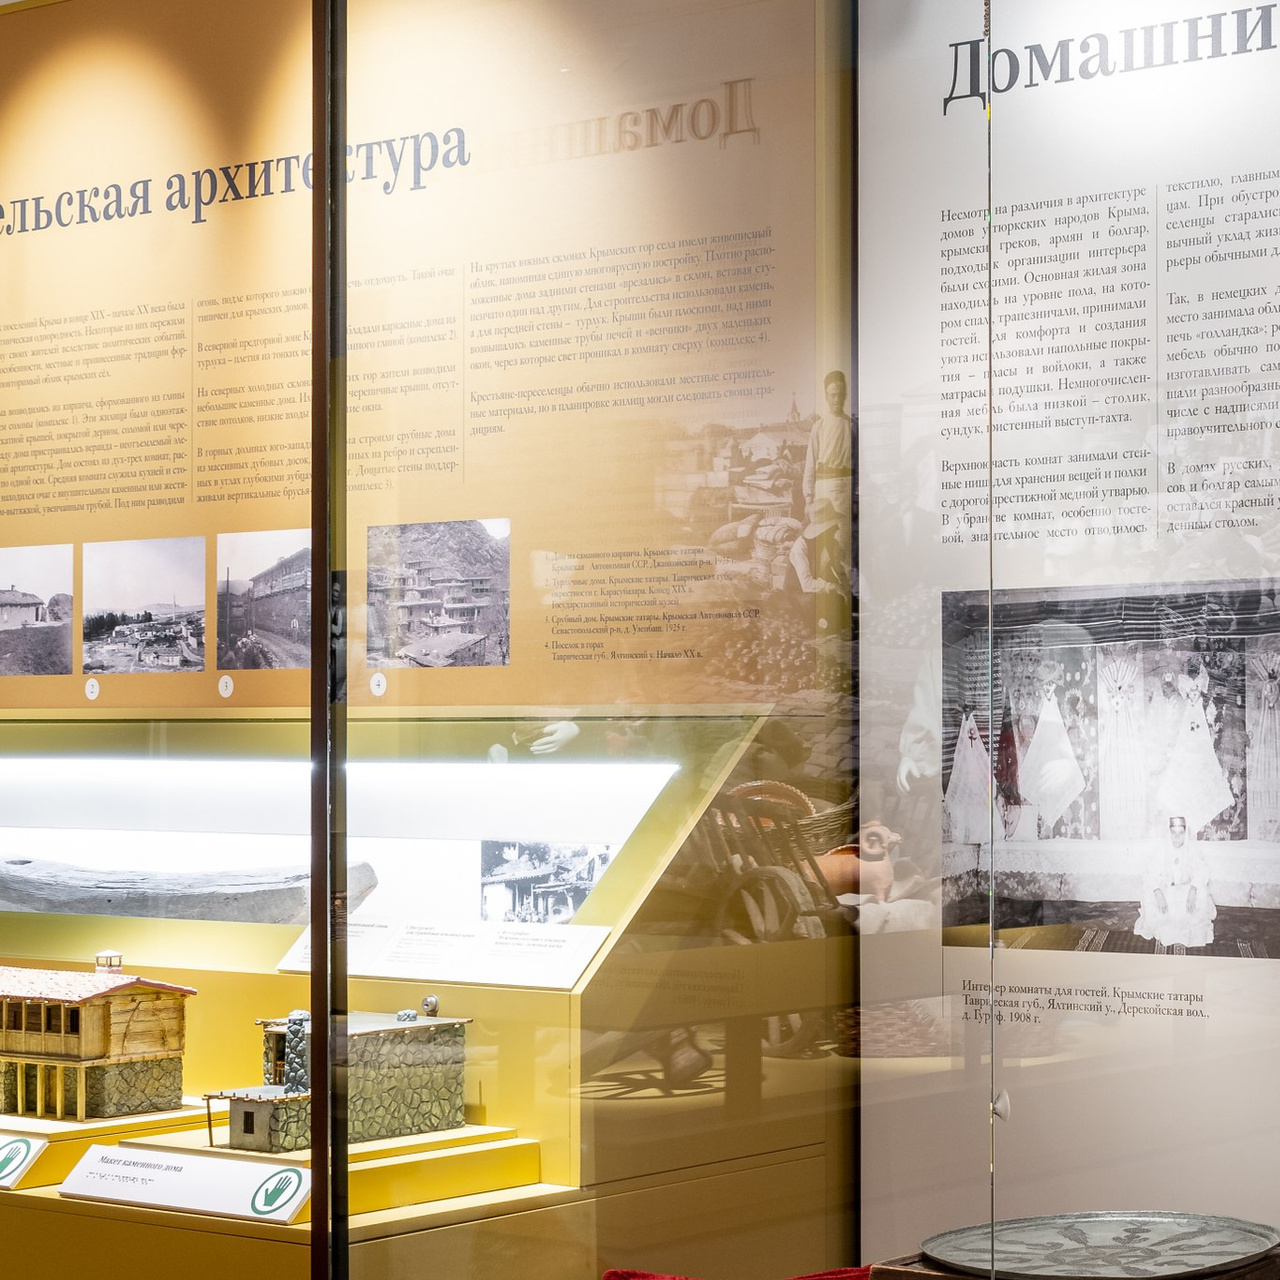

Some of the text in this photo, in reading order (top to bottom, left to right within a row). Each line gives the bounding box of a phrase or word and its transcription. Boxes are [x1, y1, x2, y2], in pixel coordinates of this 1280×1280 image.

[1165, 177, 1222, 192] текстилю,
[1230, 169, 1280, 184] главным
[1166, 201, 1190, 214] цам.
[1198, 192, 1224, 211] При
[1165, 215, 1214, 230] селенцы
[1166, 231, 1212, 249] вычный
[1216, 230, 1251, 247] уклад
[1166, 255, 1201, 272] рьеры
[1204, 247, 1267, 263] обычными
[1166, 290, 1189, 306] Так,
[1197, 292, 1204, 302] в
[1211, 286, 1267, 300] немецких
[1166, 312, 1199, 324] место
[1201, 307, 1254, 321] занимала
[1166, 332, 1192, 343] печь
[1195, 324, 1267, 340] «голландка»;
[1166, 345, 1206, 361] мебель
[1213, 342, 1258, 357] обычно
[1166, 364, 1250, 380] изготавливать
[1166, 388, 1196, 399] шали
[962, 980, 1203, 1006] Интеер комнаты для гостей. Крымские татары
[962, 994, 1209, 1019] Тавриеская губ., Ялтинский у., Дерекойская вол.,
[962, 1012, 971, 1020] д.
[1009, 1007, 1031, 1022] 1908
[1033, 1015, 1041, 1023] г.
[99, 1155, 122, 1165] Макет
[122, 1160, 163, 1170] каменного
